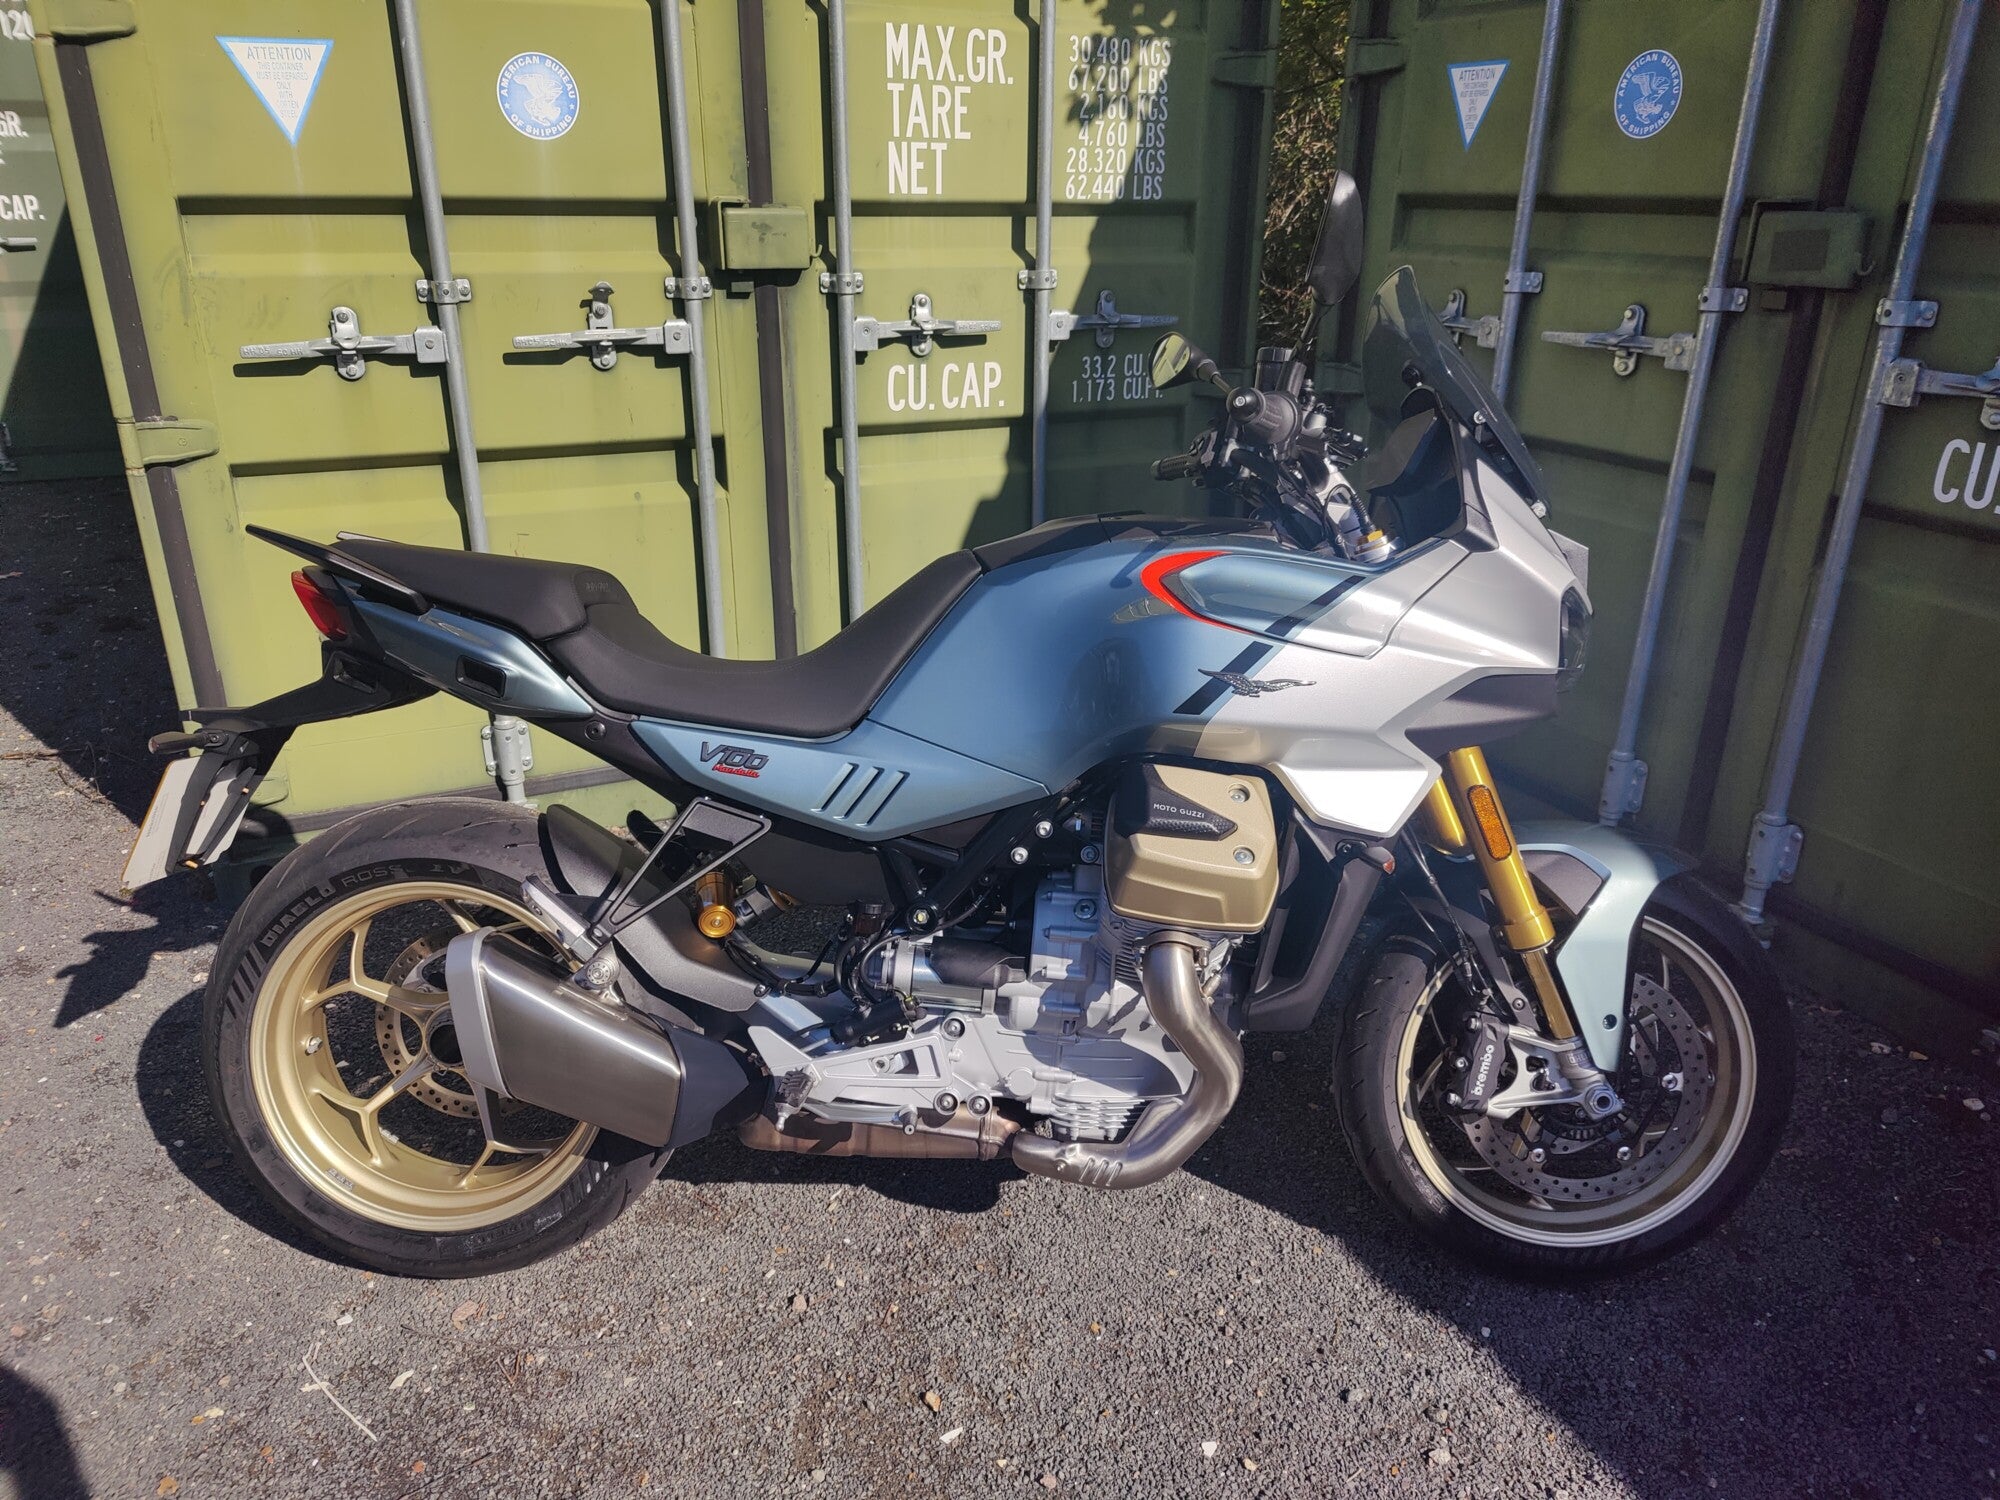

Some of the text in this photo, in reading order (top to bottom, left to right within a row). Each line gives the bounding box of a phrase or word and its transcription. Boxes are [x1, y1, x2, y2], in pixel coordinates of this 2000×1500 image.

[247, 46, 312, 61] ATTENTION
[886, 22, 1014, 85] MAX.GR.
[1069, 35, 1171, 67] 30,480 KGS
[501, 55, 576, 98] AMERICAN BUREAU
[1068, 64, 1168, 95] 67,200 LBS
[1459, 68, 1496, 81] ATTENTION
[1618, 53, 1680, 98] AMERICAN BUREAU
[887, 83, 971, 140] TARE
[1080, 92, 1168, 121] 2,160 KGS
[511, 113, 572, 137] OF SHIPPING
[1078, 120, 1165, 148] 4,760 LBS
[1620, 111, 1670, 136] OF SHIPPING
[888, 141, 947, 195] NET
[1066, 147, 1166, 174] 28,320 KGS
[1065, 174, 1162, 200] 62,440 LBS
[1081, 354, 1117, 380] 33.2
[887, 361, 1005, 412] CU. CAP.
[1072, 379, 1116, 404] 1,173
[700, 741, 770, 770] V100
[1153, 803, 1206, 819] MOTO GUZZI
[1470, 1044, 1496, 1096] brembo
